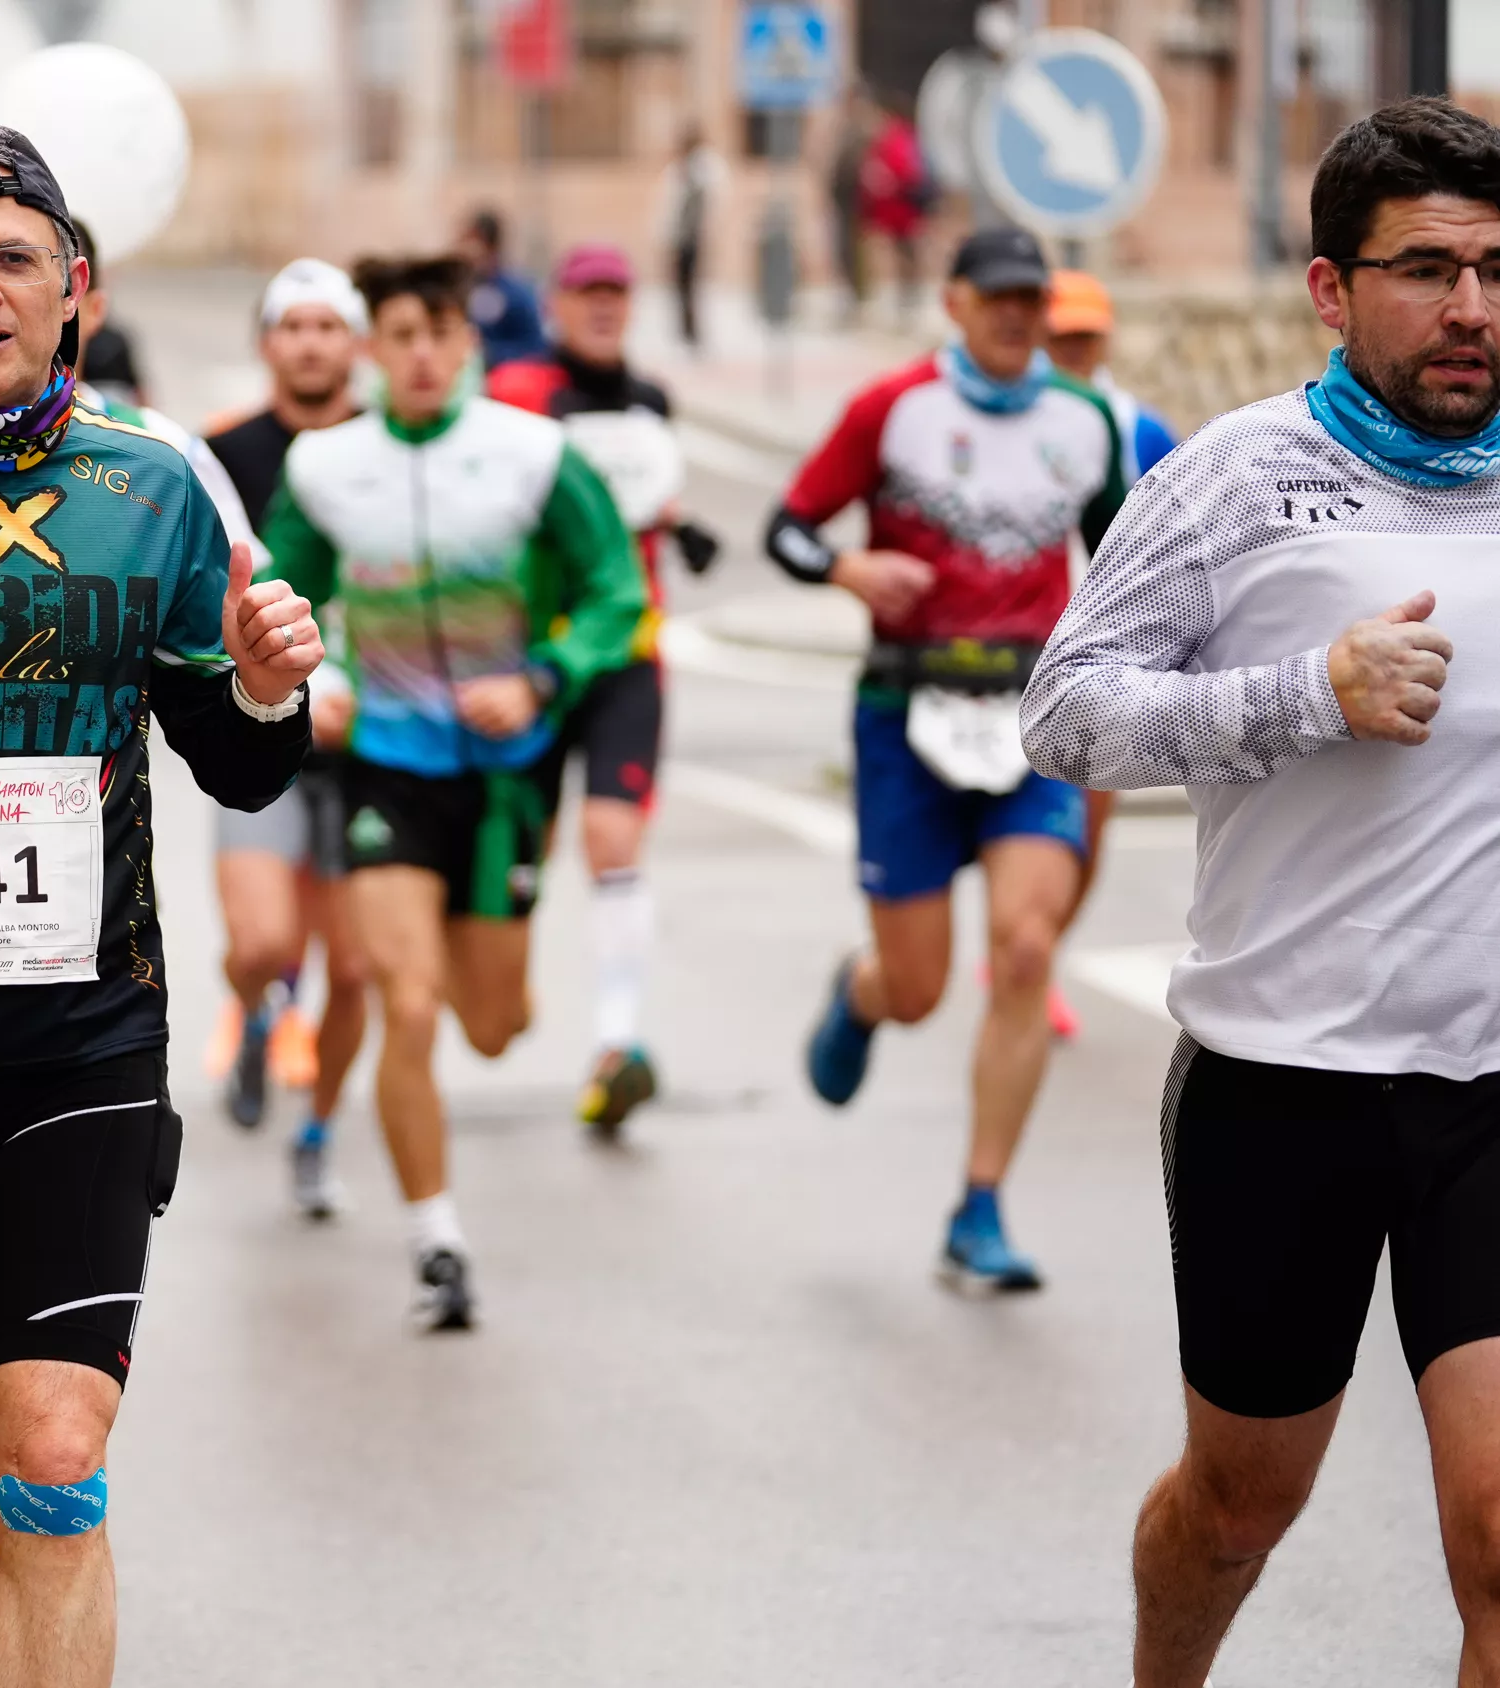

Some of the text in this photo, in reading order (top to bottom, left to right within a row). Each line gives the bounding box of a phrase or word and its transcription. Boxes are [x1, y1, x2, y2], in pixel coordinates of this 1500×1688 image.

[1364, 450, 1414, 484] Mobility
[69, 454, 163, 517] SIG Laboral
[17, 923, 60, 932] MONTORO
